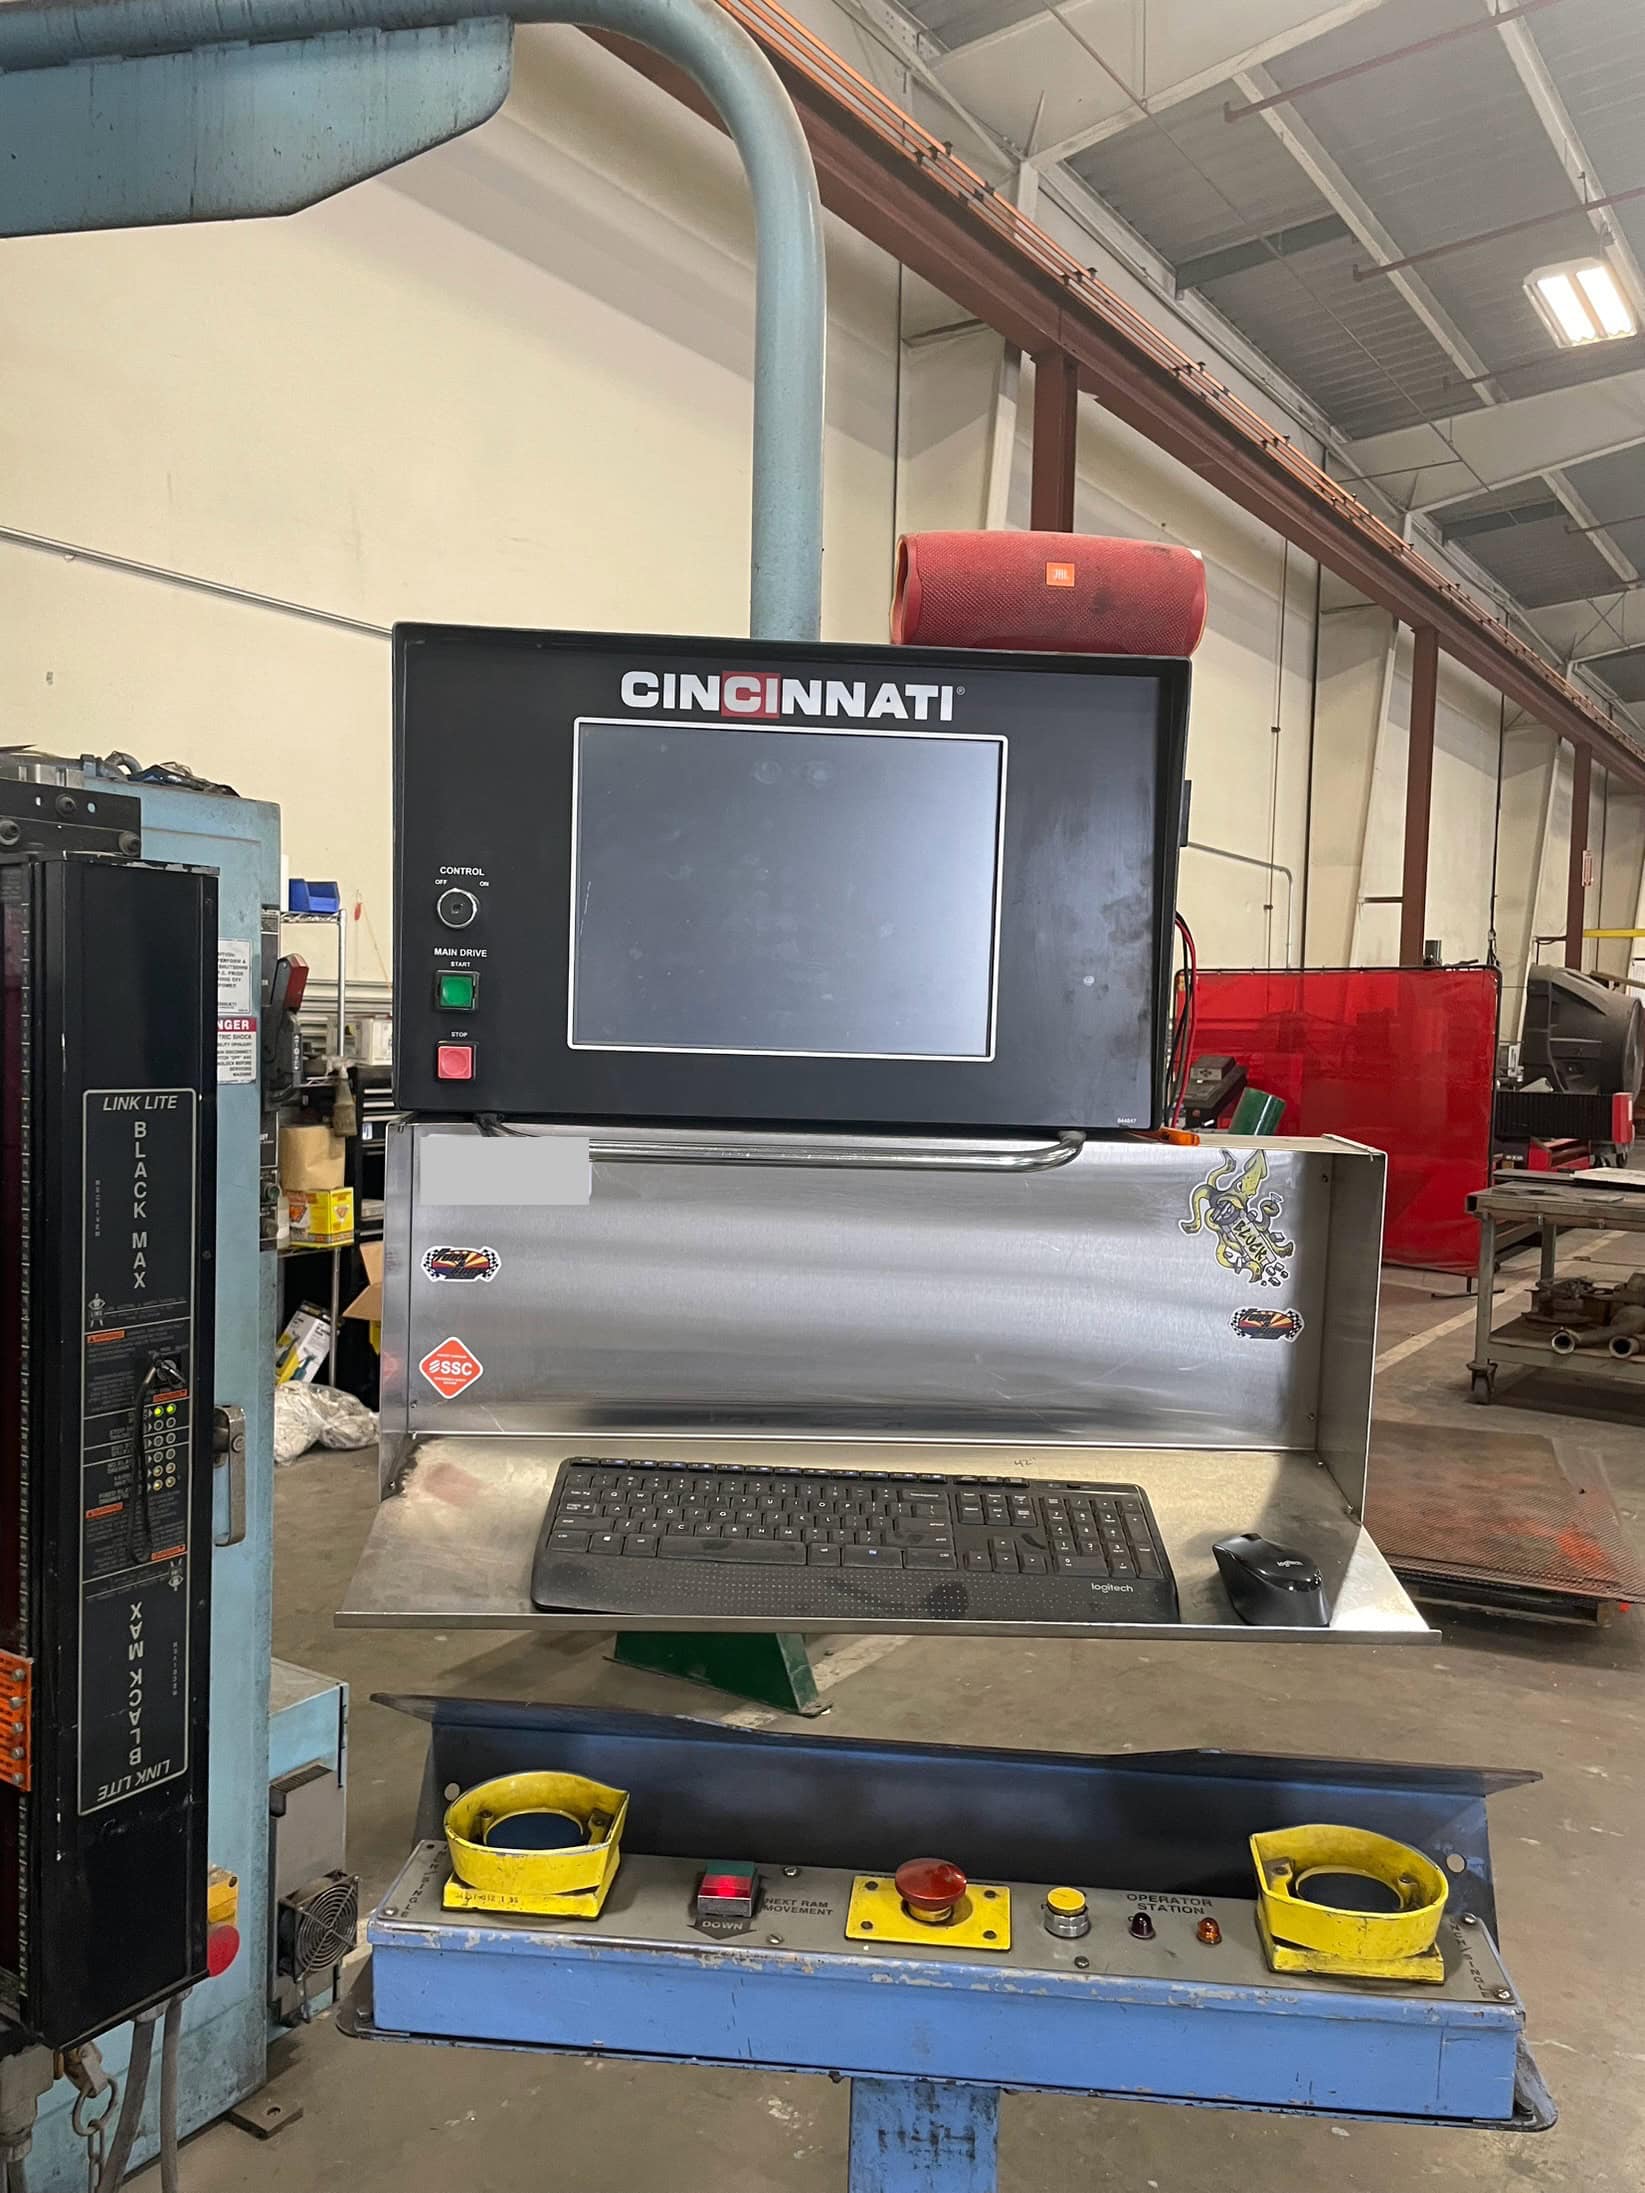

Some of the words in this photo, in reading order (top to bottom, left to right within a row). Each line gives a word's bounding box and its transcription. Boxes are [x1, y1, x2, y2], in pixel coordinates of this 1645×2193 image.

[1054, 568, 1069, 580] JBL
[621, 670, 953, 721] CINCINNATI
[440, 866, 485, 876] CONTROL
[434, 947, 458, 957] MAIN
[460, 948, 488, 958] DRIVE
[218, 1019, 250, 1030] NGER
[102, 1096, 141, 1111] LINK
[144, 1095, 178, 1110] LITE
[133, 1121, 148, 1219] BLACK
[131, 1231, 148, 1289] MAX
[440, 1360, 473, 1376] SSC
[1091, 1582, 1134, 1594] logitech
[128, 1601, 144, 1661] MAX
[128, 1667, 143, 1766] BLACK
[135, 1758, 171, 1787] LINK
[97, 1775, 131, 1802] LITE
[765, 1897, 797, 1906] NEXT
[801, 1899, 828, 1908] RAM
[1126, 1893, 1214, 1907] OPERATOR
[763, 1904, 833, 1916] MOVEMENT
[1137, 1902, 1205, 1914] STATION
[702, 1920, 743, 1930] DOWN
